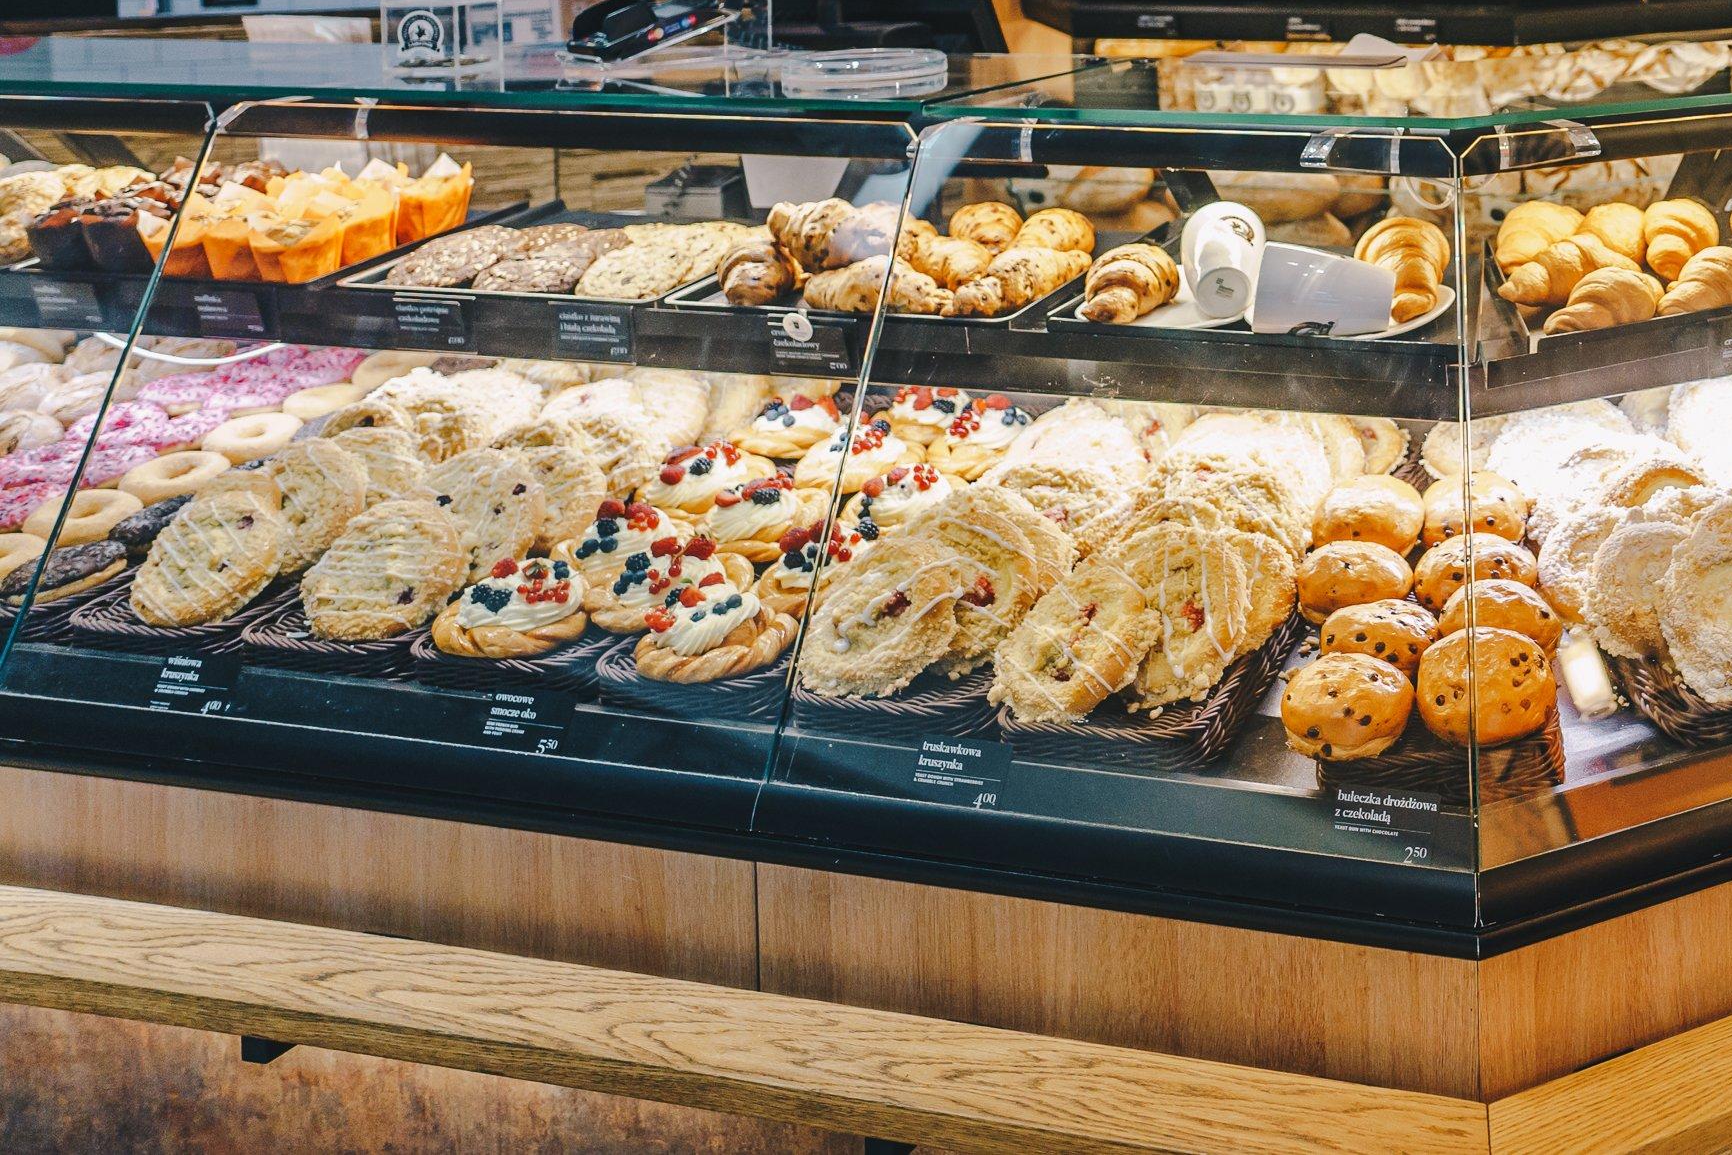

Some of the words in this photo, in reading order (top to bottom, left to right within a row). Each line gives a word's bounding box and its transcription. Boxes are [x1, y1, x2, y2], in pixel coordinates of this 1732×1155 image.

[160, 667, 200, 682] kruszynka
[495, 693, 535, 705] owocowe
[490, 706, 520, 718] smocze
[520, 708, 537, 720] oko
[922, 740, 982, 757] truskawkowa
[917, 754, 963, 771] kruszynka
[1337, 789, 1381, 805] bułeczka
[1382, 794, 1438, 812] drożdżowa
[1334, 808, 1341, 817] z
[1342, 807, 1391, 825] czekoladą
[1371, 829, 1399, 837] CHOCOLATE
[1403, 846, 1428, 864] 250
